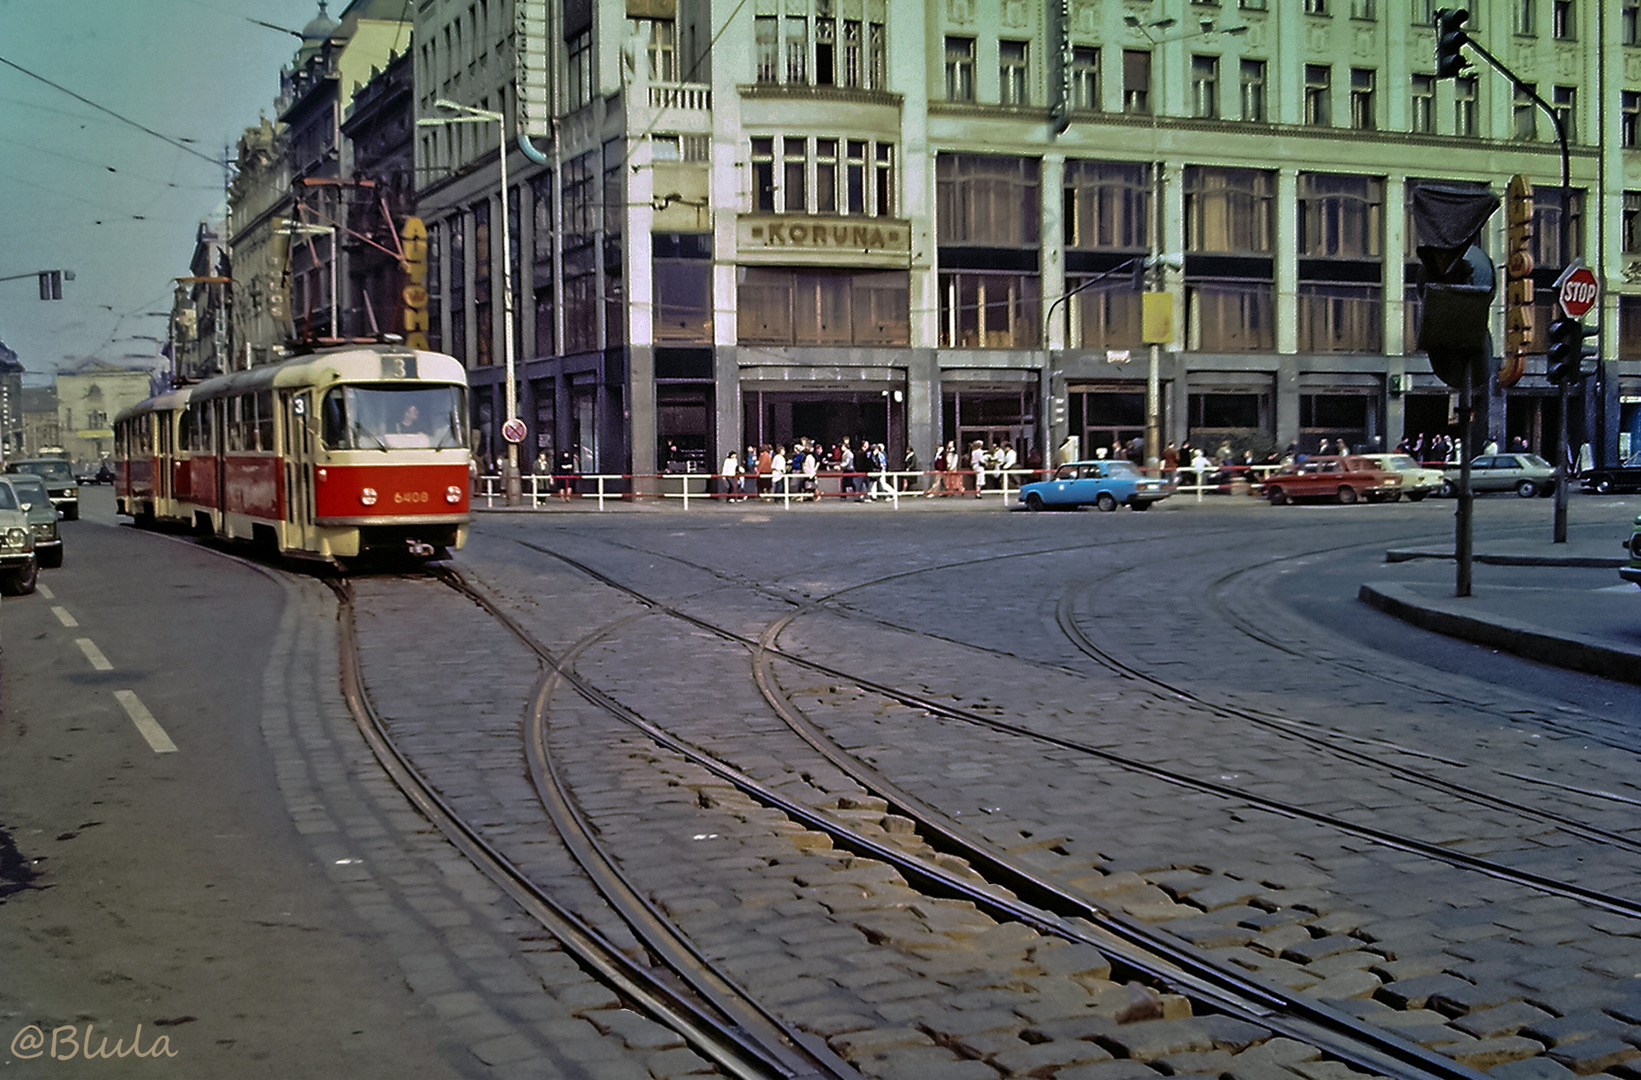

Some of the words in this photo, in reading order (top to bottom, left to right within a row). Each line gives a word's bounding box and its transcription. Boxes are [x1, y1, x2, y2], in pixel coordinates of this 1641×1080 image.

[769, 222, 885, 248] KORUNA
[1564, 281, 1596, 304] STOP
[394, 358, 406, 378] 3
[295, 399, 304, 414] 3
